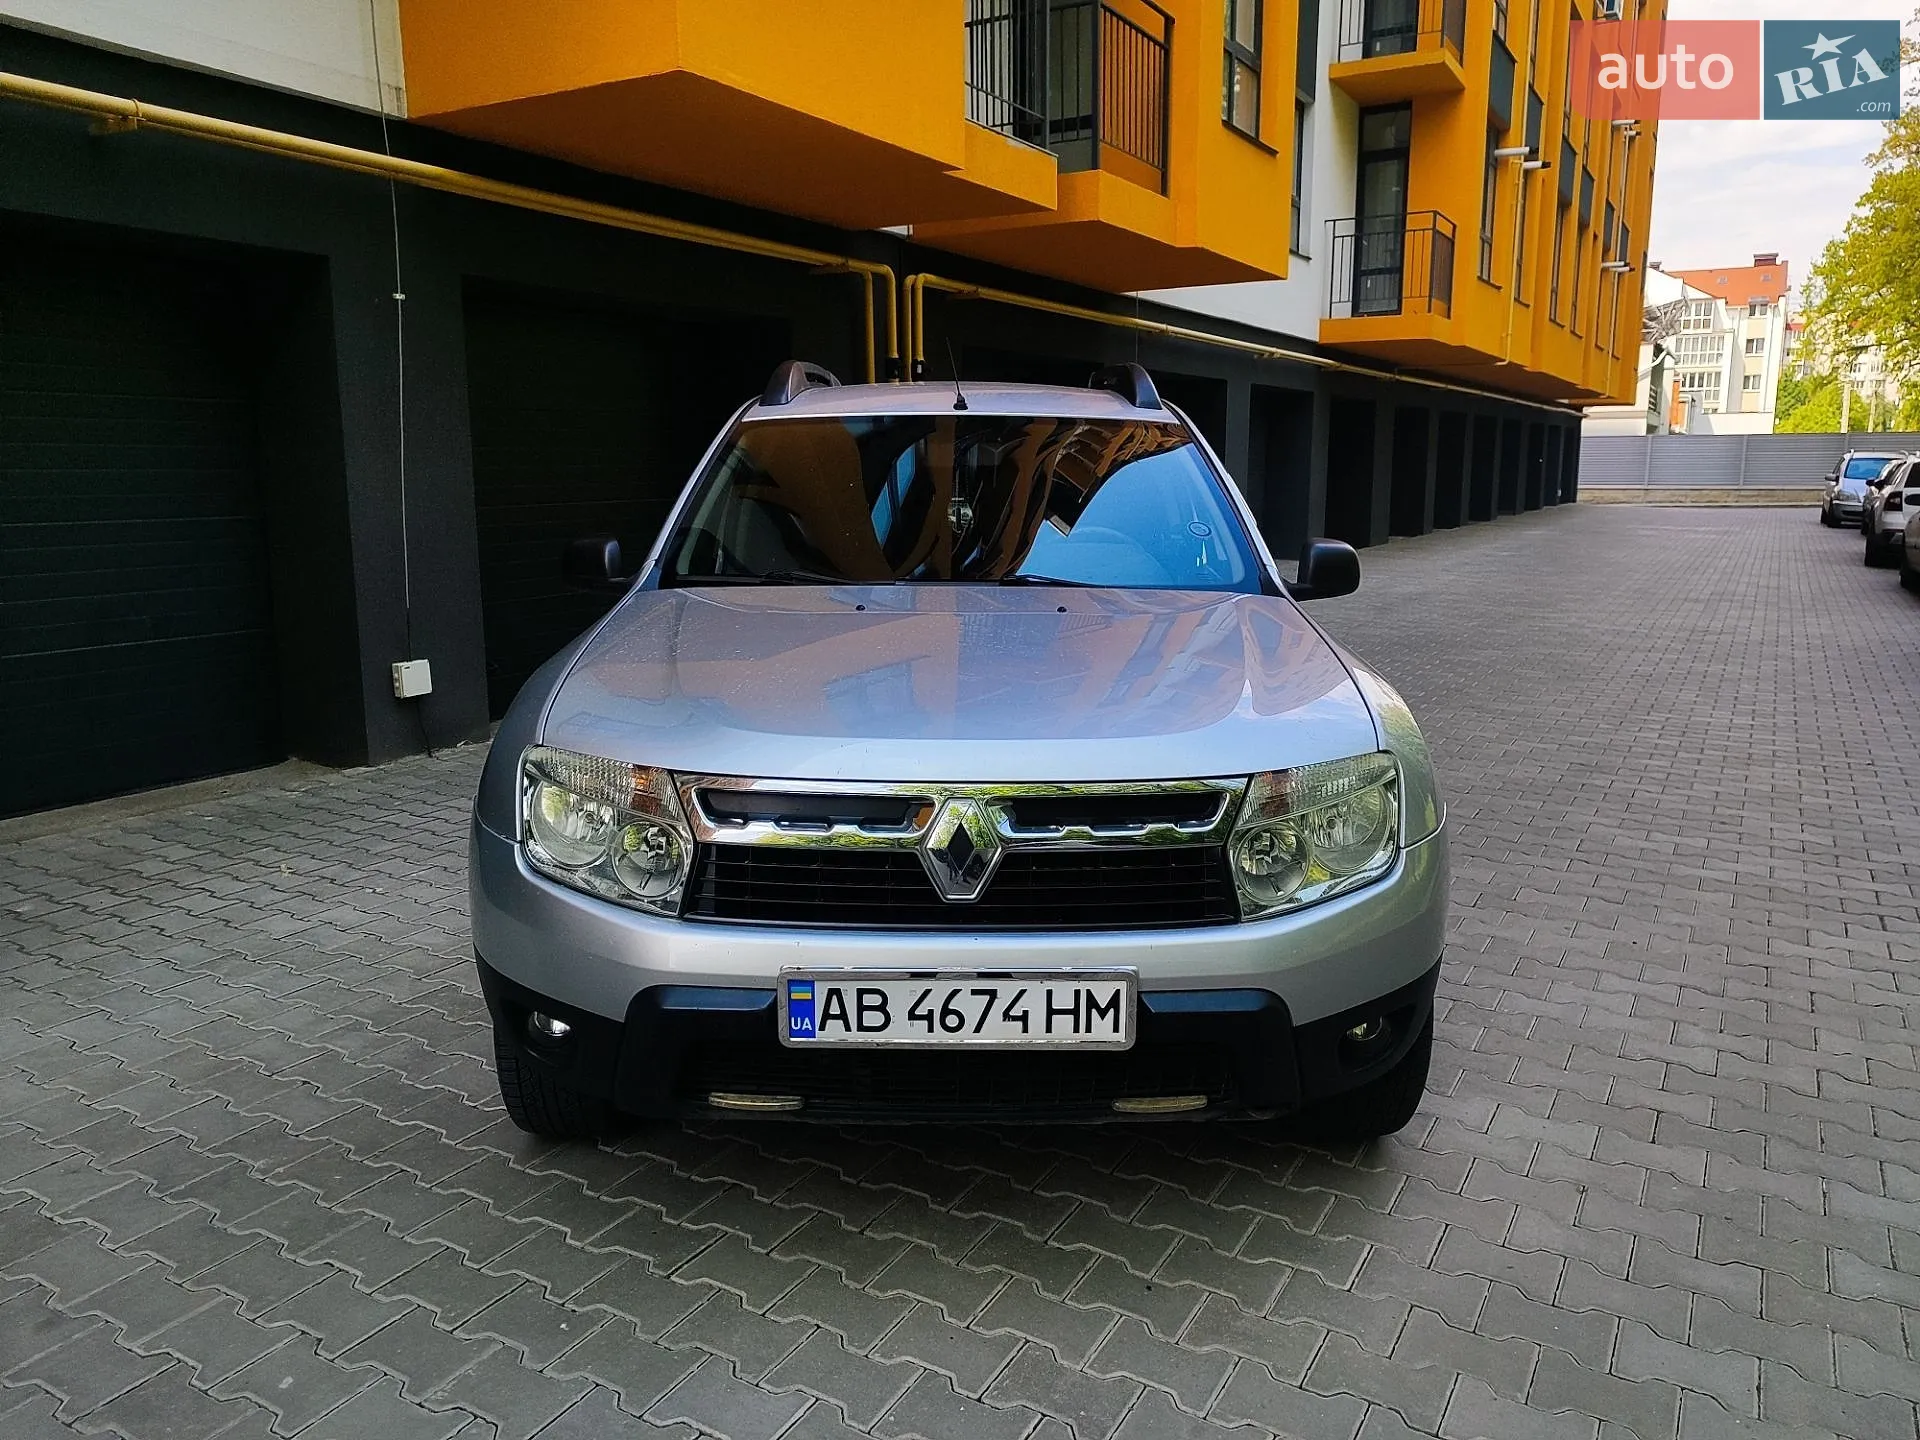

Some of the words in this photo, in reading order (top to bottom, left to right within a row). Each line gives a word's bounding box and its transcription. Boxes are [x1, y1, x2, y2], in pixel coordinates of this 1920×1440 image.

[791, 1017, 813, 1031] UA
[818, 987, 892, 1033] AB
[907, 988, 1029, 1034] 4674
[1045, 988, 1120, 1034] HM
